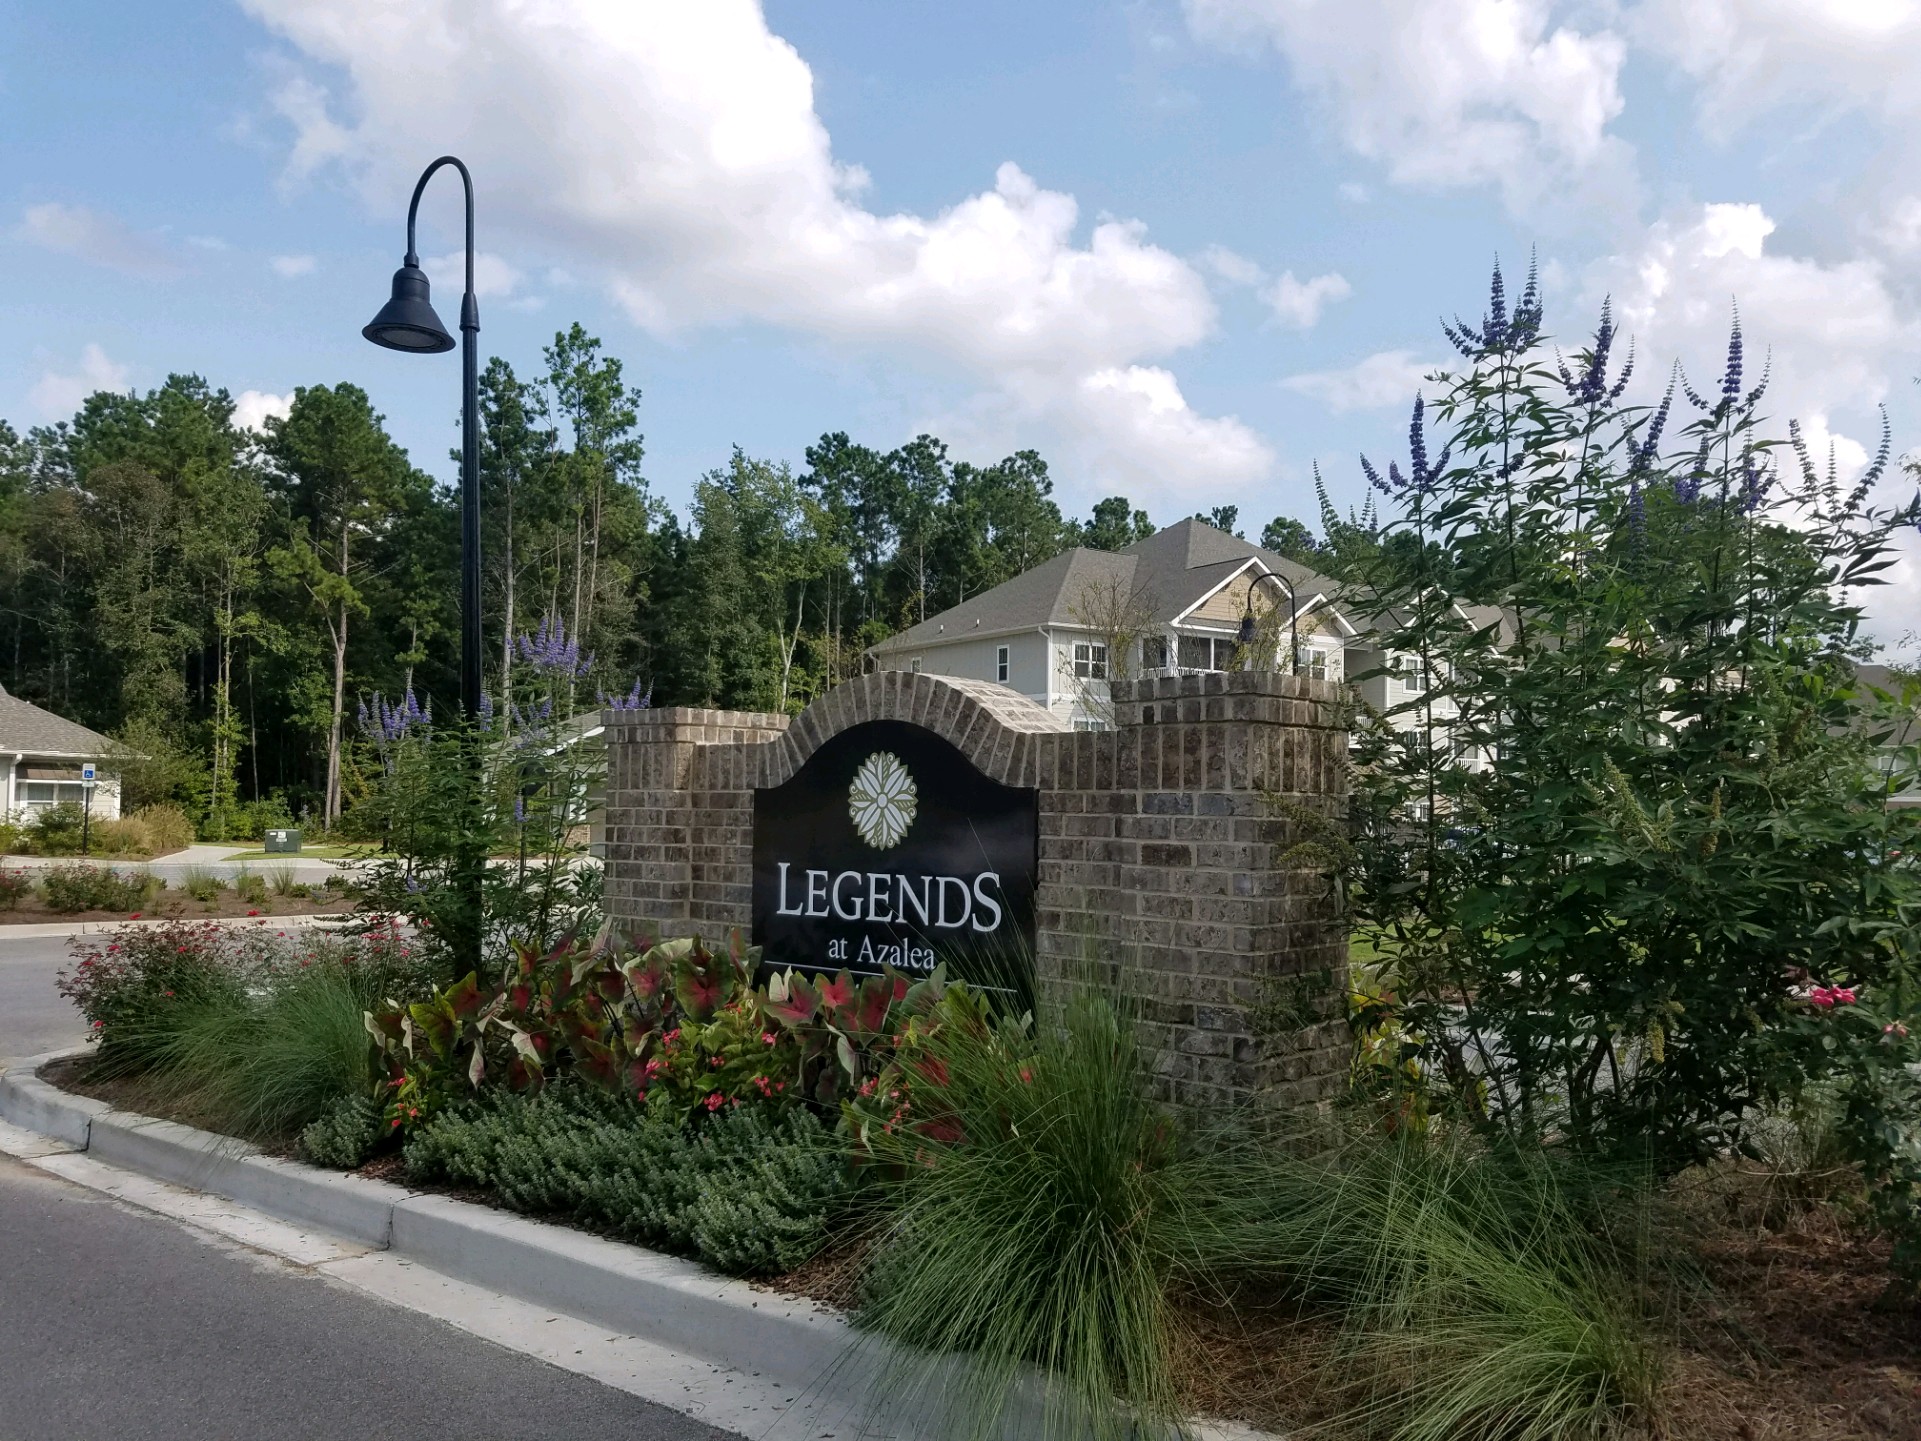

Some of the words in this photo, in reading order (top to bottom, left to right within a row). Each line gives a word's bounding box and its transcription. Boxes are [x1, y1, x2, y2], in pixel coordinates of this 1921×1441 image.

[776, 862, 1002, 932] LEGENDS
[828, 937, 848, 960] at
[856, 934, 936, 970] Azalea
